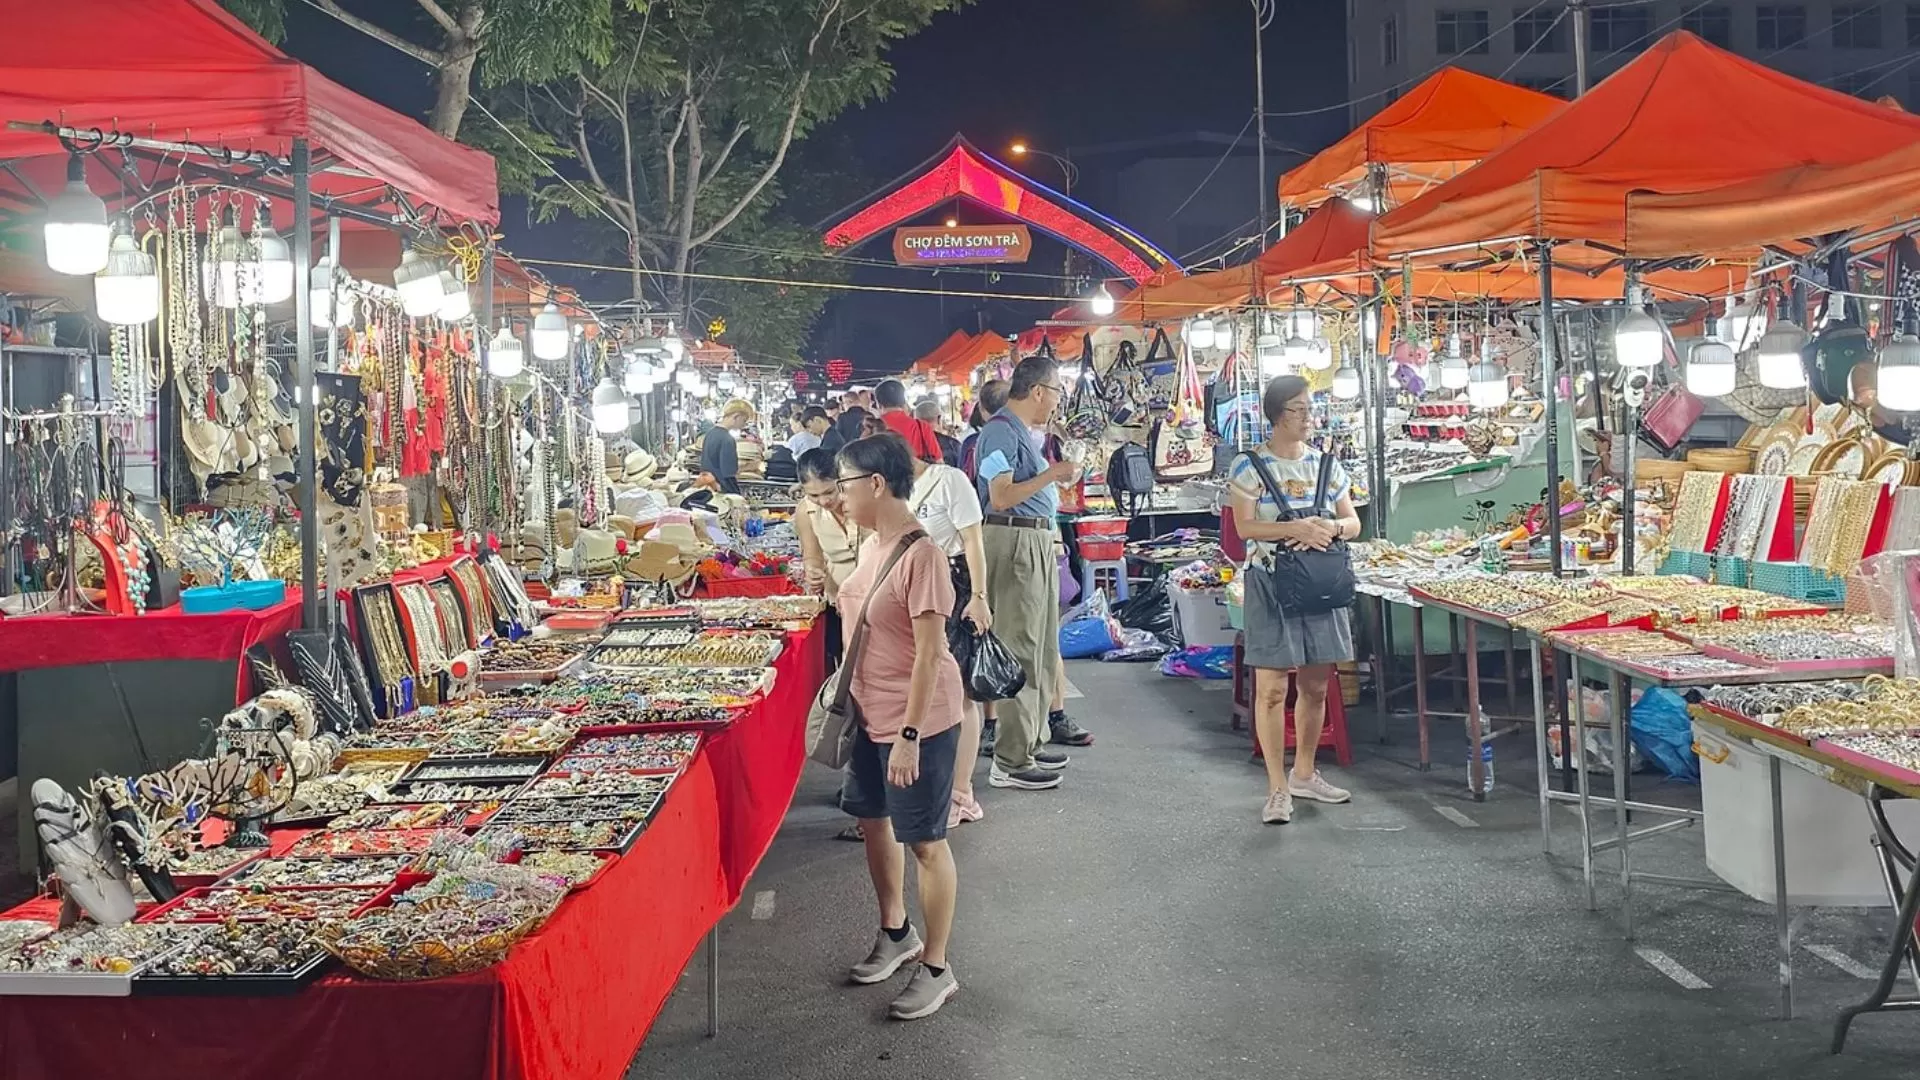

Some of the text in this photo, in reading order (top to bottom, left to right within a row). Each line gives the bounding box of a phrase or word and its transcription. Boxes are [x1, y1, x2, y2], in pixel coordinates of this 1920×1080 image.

[904, 232, 1020, 250] CHỢ ĐÊM SƠN TRÀ
